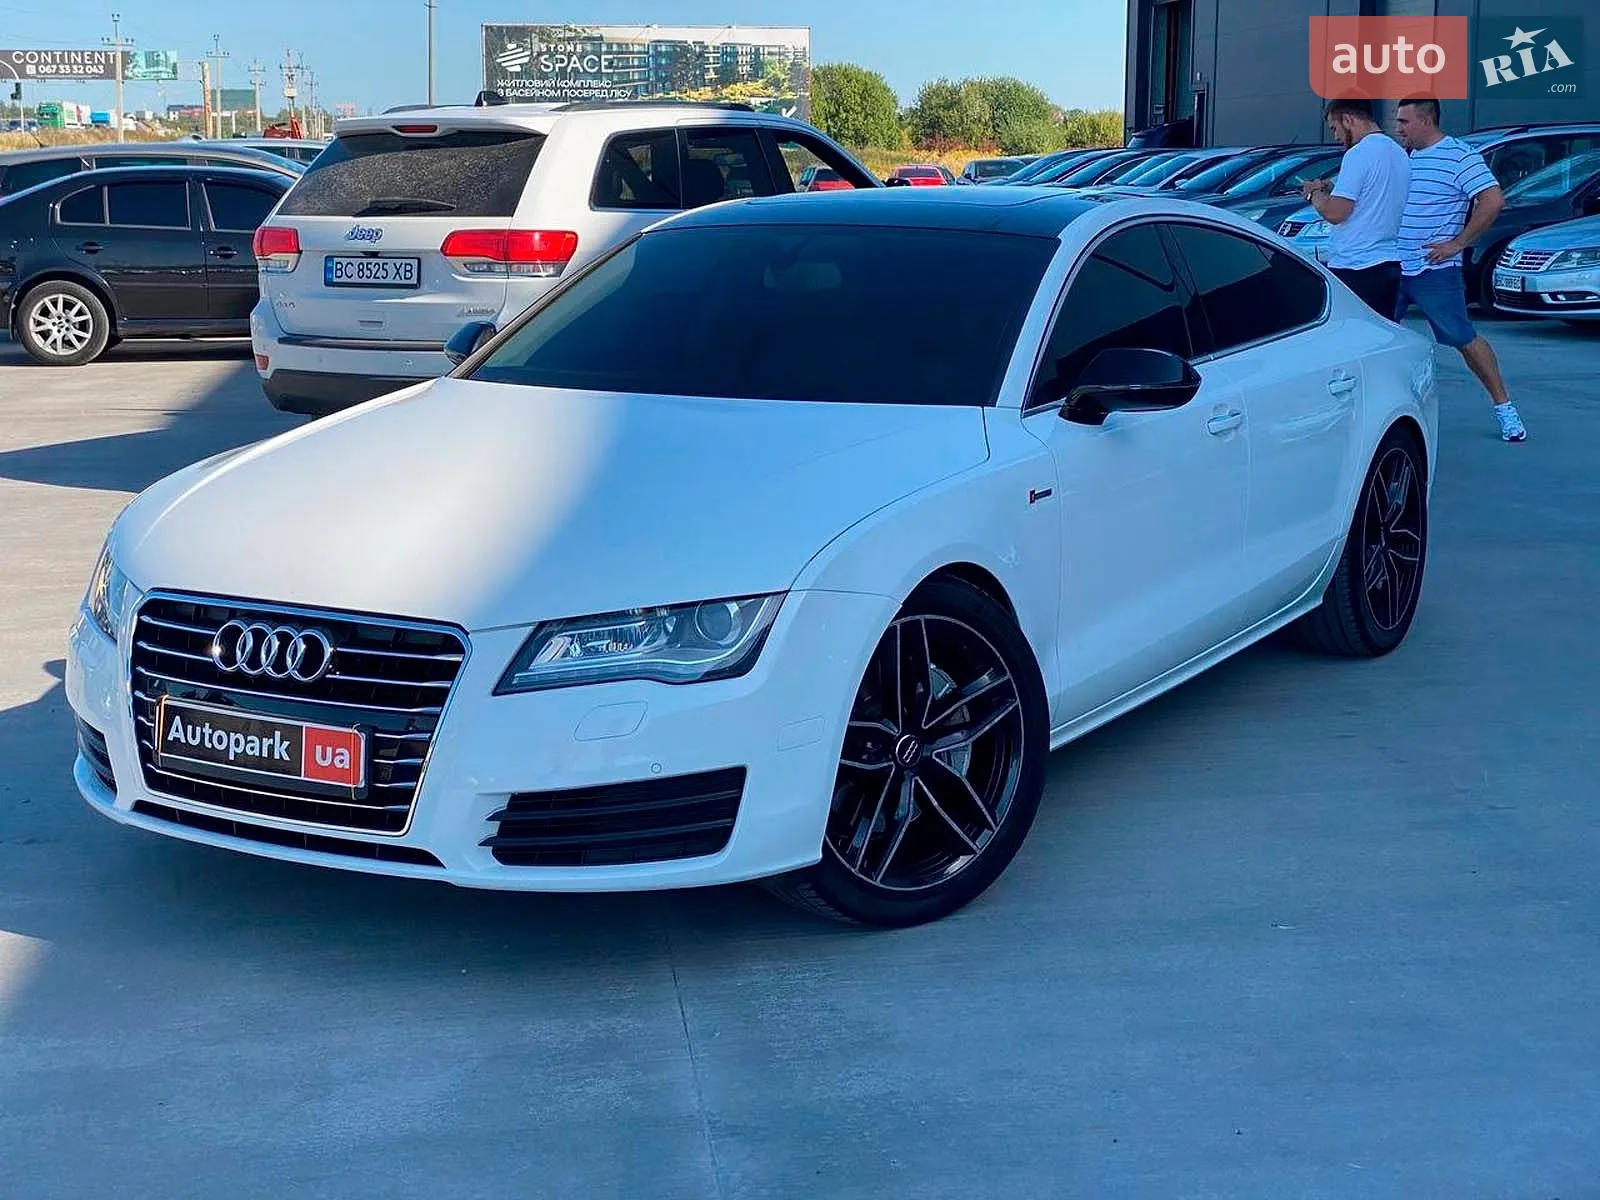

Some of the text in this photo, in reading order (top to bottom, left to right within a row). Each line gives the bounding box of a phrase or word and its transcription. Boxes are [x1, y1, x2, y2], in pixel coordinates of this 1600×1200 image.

[540, 42, 583, 52] STONE
[12, 51, 115, 64] CONTINENT
[540, 54, 613, 73] SPACE
[38, 65, 56, 74] 067
[497, 79, 556, 88] ЖИТЛОВИЙ
[506, 89, 561, 98] БАСЕЙНОМ
[562, 89, 608, 98] ПОСЕРЕД
[609, 89, 632, 98] ЛІСУ
[346, 226, 384, 242] Jeep
[335, 262, 414, 281] BC 8525 XB
[167, 715, 350, 769] Autopark ua
